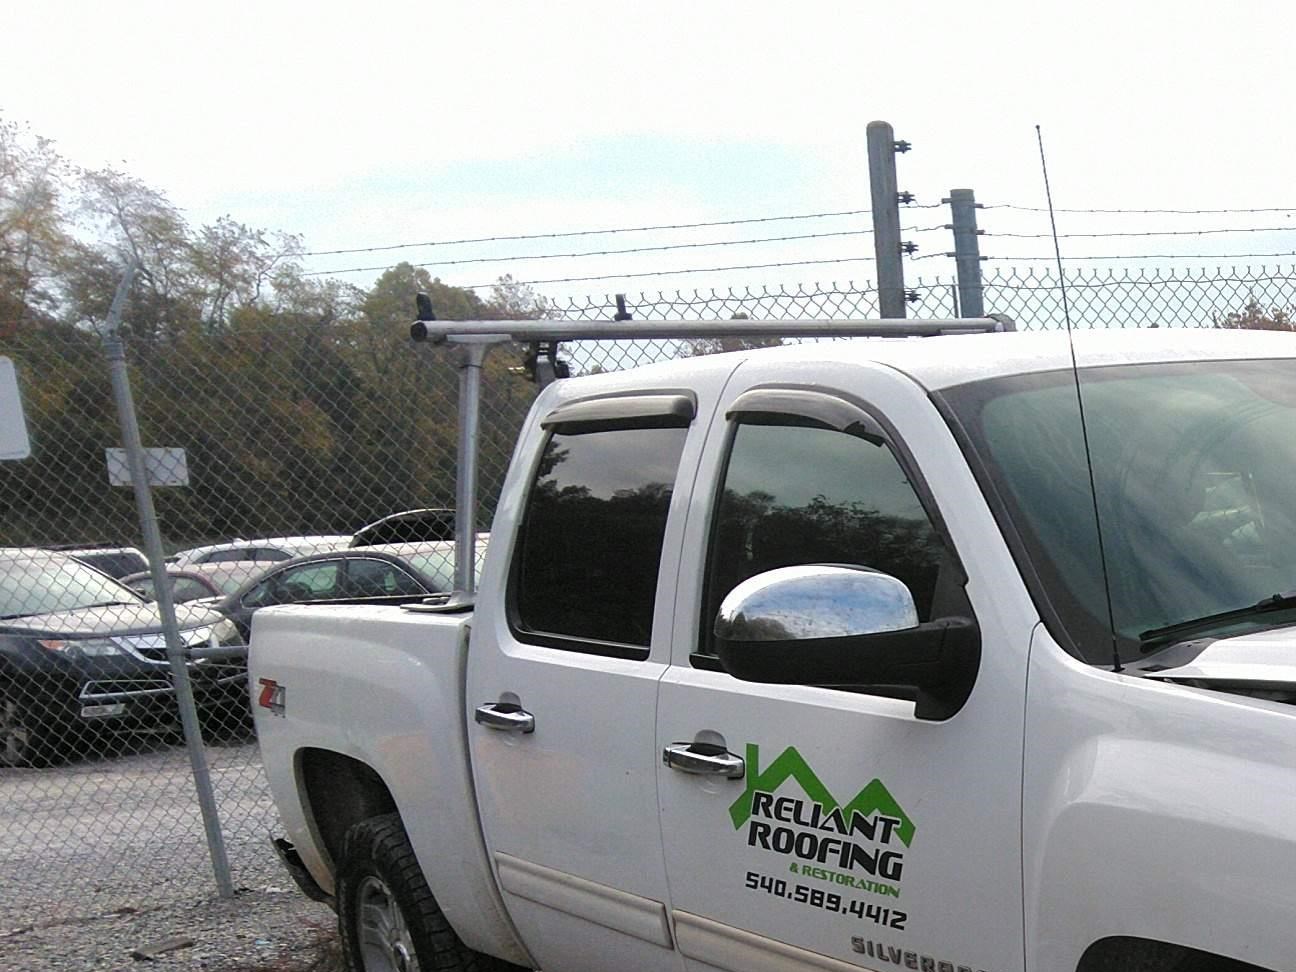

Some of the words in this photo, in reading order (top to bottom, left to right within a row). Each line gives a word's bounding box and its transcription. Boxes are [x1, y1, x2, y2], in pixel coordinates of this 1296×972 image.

[751, 791, 900, 845] RELIANT
[748, 820, 904, 882] ROOFING
[745, 871, 908, 931] 540.589.4412
[789, 862, 799, 874] &
[802, 865, 901, 898] RESTORATION
